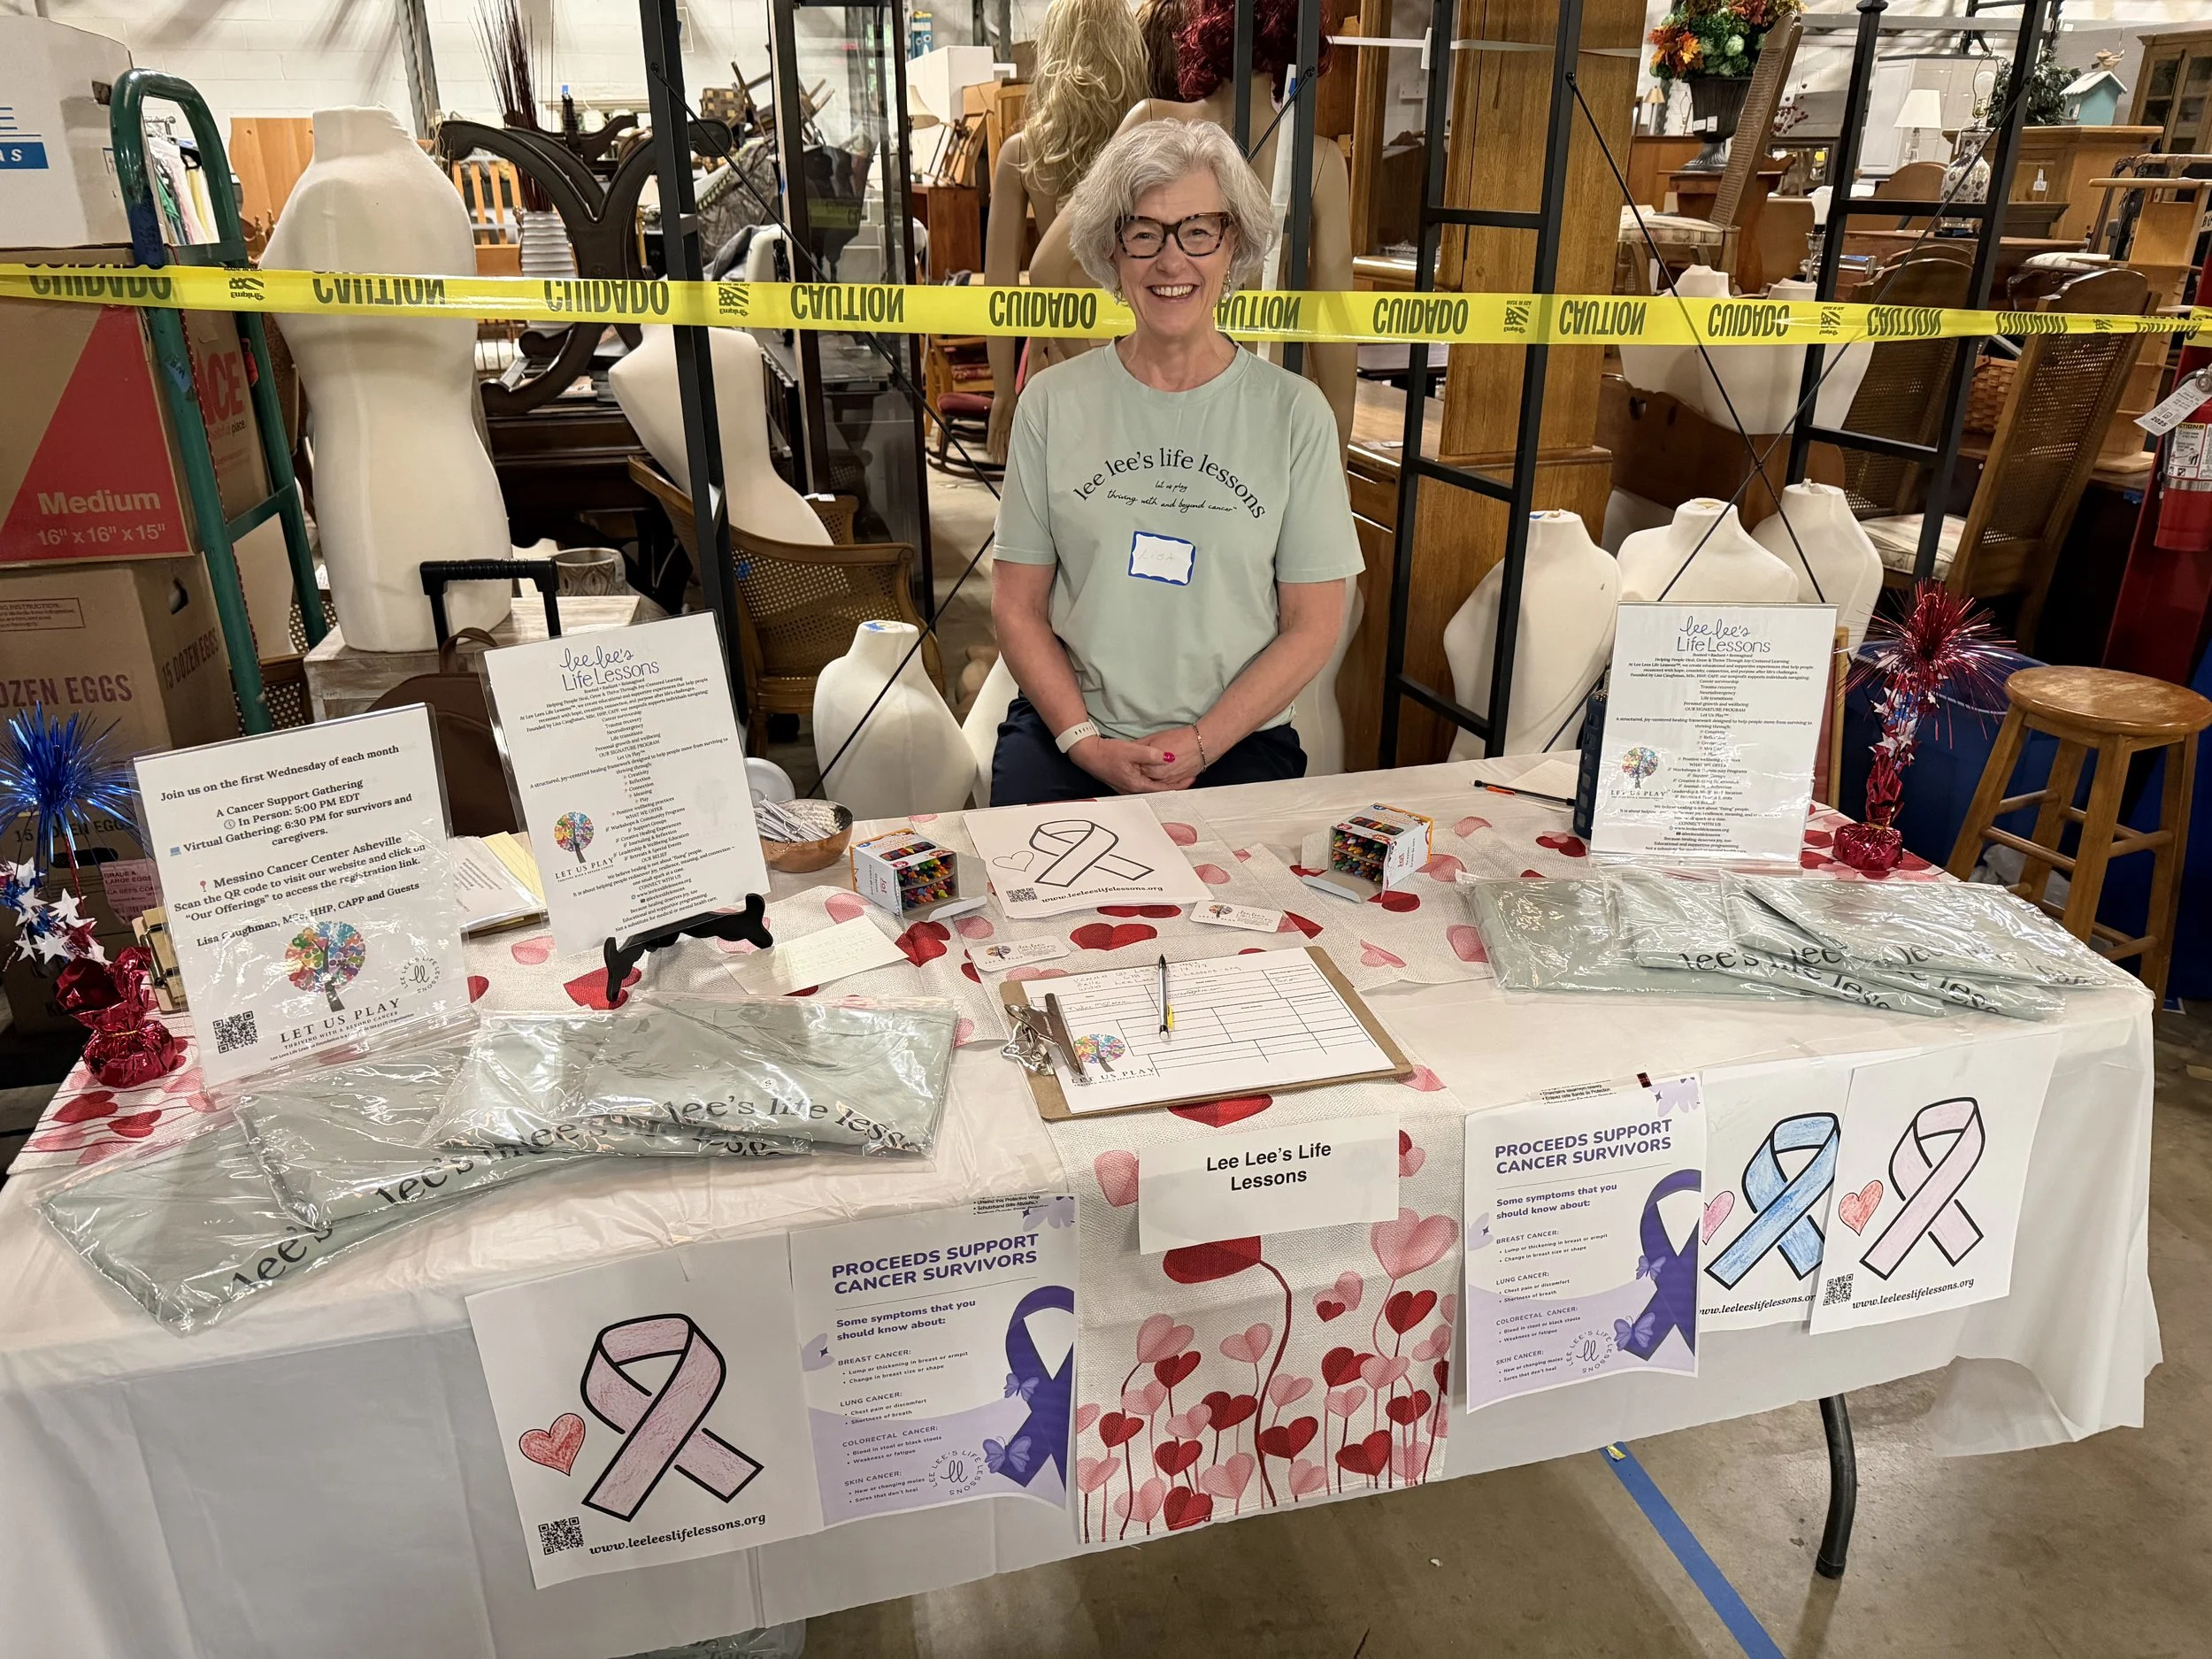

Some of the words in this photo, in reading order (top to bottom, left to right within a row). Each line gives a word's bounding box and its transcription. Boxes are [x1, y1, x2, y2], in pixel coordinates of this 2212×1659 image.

[1072, 472, 1105, 501] lee
[1104, 451, 1154, 476] lee’s
[1159, 448, 1194, 470] life
[1198, 454, 1265, 518] lessons
[37, 489, 161, 515] Medium
[1161, 498, 1176, 508] and
[1179, 497, 1204, 513] beyond
[37, 528, 67, 545] 16"
[73, 532, 85, 543] x
[87, 526, 117, 542] 16"
[122, 529, 134, 541] x
[135, 523, 165, 540] 15"
[1677, 636, 1705, 652] Life
[1708, 636, 1770, 653] Lessons
[174, 645, 200, 682] DOZEN
[562, 671, 594, 692] Life
[594, 659, 660, 686] Lessons
[65, 674, 133, 705] EGGS
[160, 789, 185, 801] Join
[186, 787, 201, 795] us
[219, 779, 238, 788] the
[240, 773, 265, 785] first
[265, 761, 326, 779] Wednesday
[328, 756, 339, 766] of
[341, 751, 365, 764] each
[366, 744, 399, 758] month
[216, 808, 225, 818] A
[226, 801, 265, 815] Cancer
[266, 791, 310, 806] Support
[311, 779, 363, 796] Gathering
[237, 818, 250, 826] In
[251, 809, 292, 823] Person:
[294, 802, 317, 814] 5:00
[319, 797, 336, 808] PM
[338, 792, 360, 804] EDT
[182, 835, 223, 851] Virtual
[225, 824, 282, 842] Gathering:
[284, 817, 306, 829] 6:30
[308, 812, 326, 824] PM
[328, 810, 343, 819] for
[345, 799, 392, 816] survivors
[394, 793, 412, 804] and
[271, 827, 328, 846] caregivers.
[212, 870, 264, 888] Messino
[266, 859, 308, 874] Cancer
[310, 849, 349, 864] Center
[352, 835, 402, 855] Asheville
[285, 884, 318, 897] access
[319, 879, 337, 888] the
[398, 856, 420, 869] link.
[554, 868, 572, 879] LET
[590, 855, 616, 869] PLAY
[173, 900, 202, 911] Scan
[203, 895, 222, 904] the
[223, 888, 242, 900] QR
[242, 882, 268, 895] code
[282, 872, 307, 884] visit
[308, 868, 326, 879] our
[327, 858, 366, 873] website
[368, 851, 387, 864] and
[388, 846, 411, 858] click
[1041, 886, 1164, 903] www.leeleeslifelessons.org
[196, 935, 219, 947] Lisa
[309, 904, 336, 917] HHP,
[337, 895, 365, 909] CAPP
[366, 889, 385, 902] and
[386, 882, 419, 896] Guests
[280, 1024, 315, 1043] LET
[323, 1014, 345, 1028] US
[353, 997, 400, 1017] PLAY
[1495, 1136, 1588, 1158] PROCEEDS
[1593, 1119, 1672, 1146] SUPPORT
[1206, 1155, 1240, 1172] Lee
[1244, 1148, 1293, 1168] Lee’s
[1298, 1142, 1333, 1160] Life
[1496, 1153, 1567, 1174] CANCER
[1572, 1137, 1671, 1164] SURVIVORS
[1230, 1168, 1308, 1192] Lessons
[1496, 1197, 1523, 1206] Some
[1525, 1190, 1575, 1202] symptoms
[1577, 1186, 1597, 1194] that
[1600, 1184, 1617, 1193] you
[1496, 1207, 1528, 1219] should
[1531, 1205, 1557, 1214] know
[1559, 1199, 1590, 1210] about:
[832, 1250, 941, 1279] PROCEEDS
[947, 1233, 1040, 1261] SUPPORT
[834, 1271, 917, 1294] CANCER
[923, 1250, 1038, 1281] SURVIVORS
[1700, 1293, 1816, 1316] ww.leeleeslifelessons.or
[1852, 1278, 1974, 1309] www.leeleeslifelessons.org
[836, 1317, 867, 1327] Some
[871, 1308, 927, 1323] symptoms
[930, 1302, 953, 1312] that
[956, 1300, 975, 1310] you
[836, 1327, 874, 1340] should
[877, 1324, 908, 1334] know
[910, 1317, 945, 1329] about:
[588, 1514, 765, 1554] www.leeleeslifelessons.org
